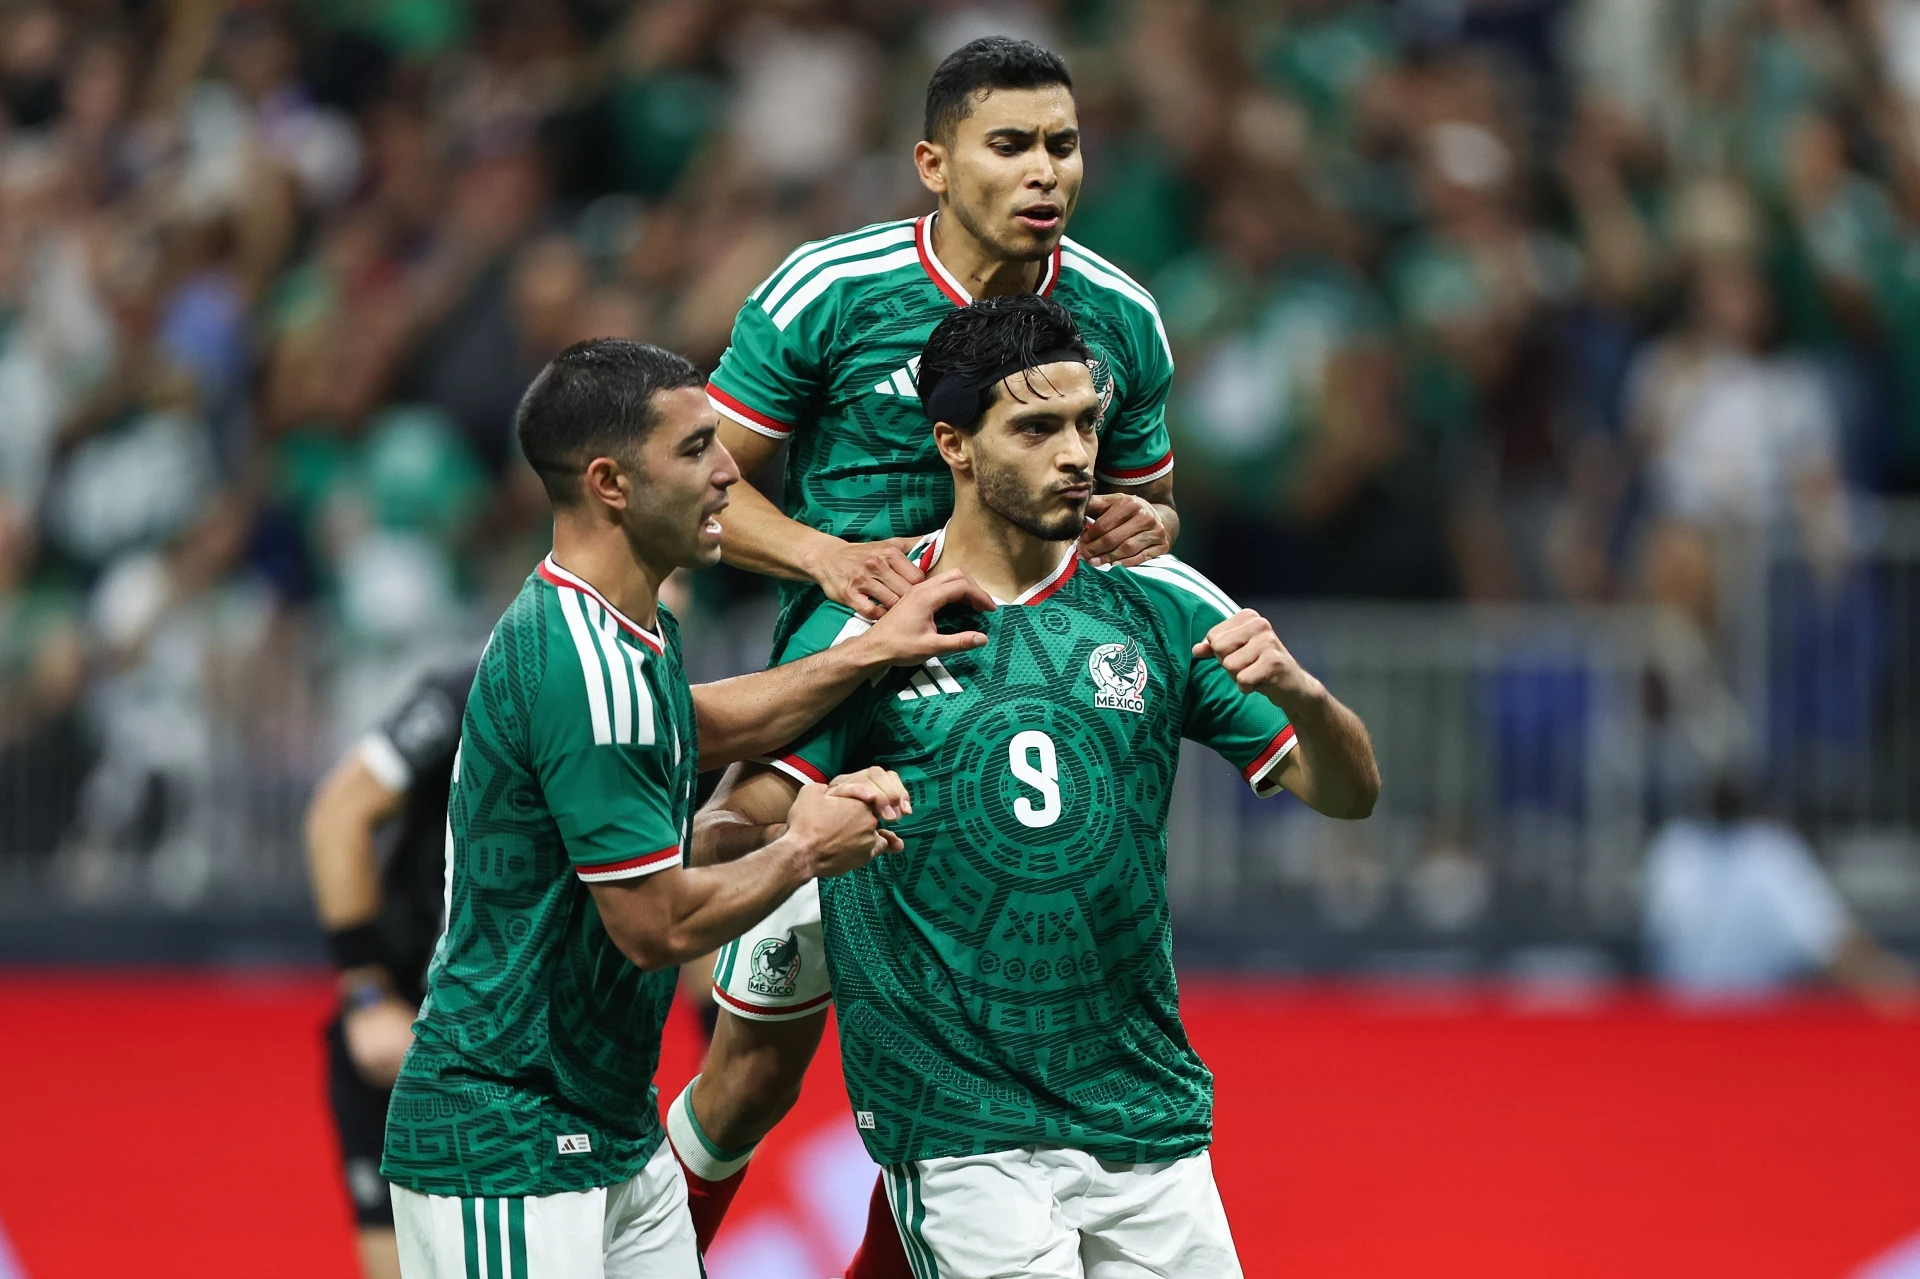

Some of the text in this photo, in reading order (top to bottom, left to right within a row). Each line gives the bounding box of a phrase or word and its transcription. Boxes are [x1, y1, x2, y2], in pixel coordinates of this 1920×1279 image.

[1096, 694, 1143, 711] MÉXICO
[1008, 730, 1061, 828] 9
[750, 981, 793, 994] MÉXICO
